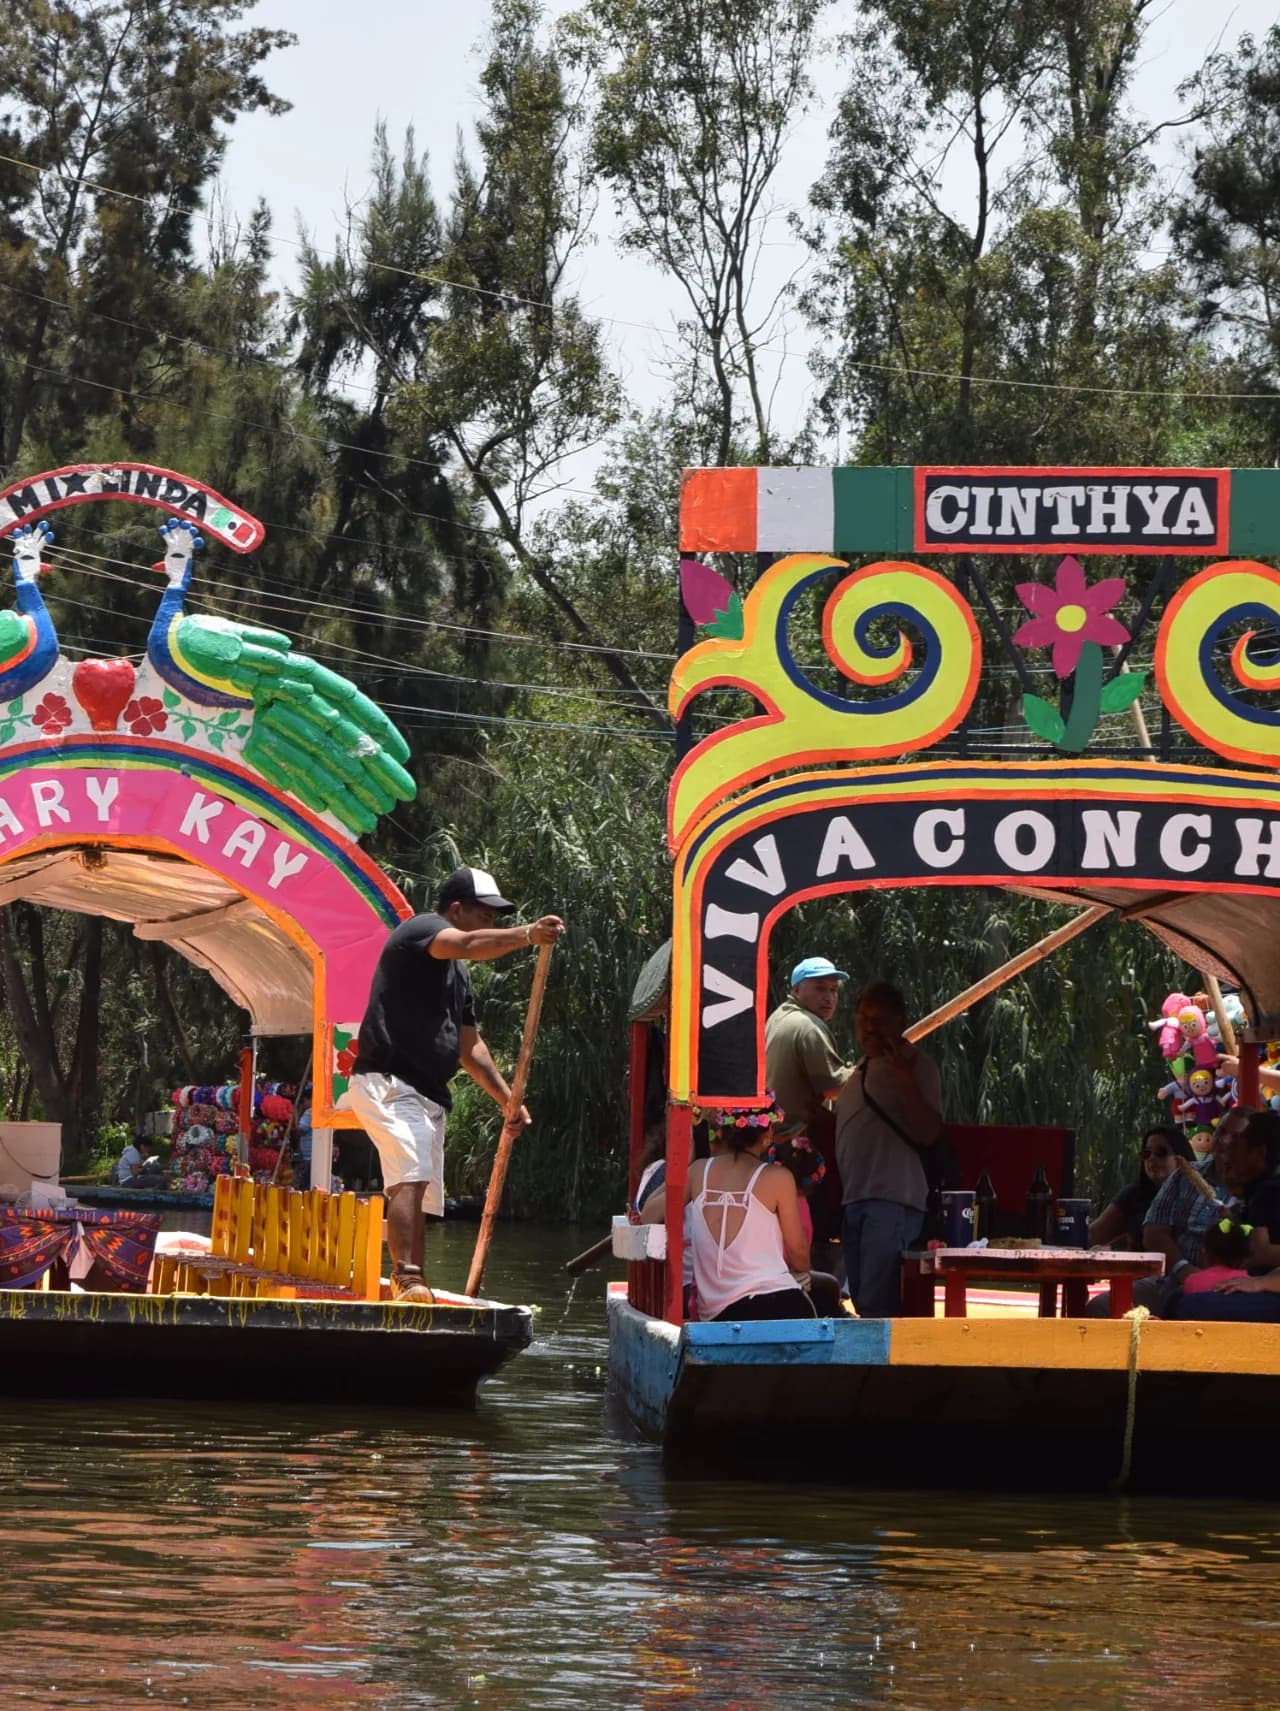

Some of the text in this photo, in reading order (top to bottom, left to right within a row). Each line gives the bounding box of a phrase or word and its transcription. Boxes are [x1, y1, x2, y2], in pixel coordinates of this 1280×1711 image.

[6, 477, 62, 516] MI
[926, 484, 1215, 537] CINTHYA
[179, 792, 309, 889] KAY
[702, 808, 1280, 1030] VIVA CONCH
